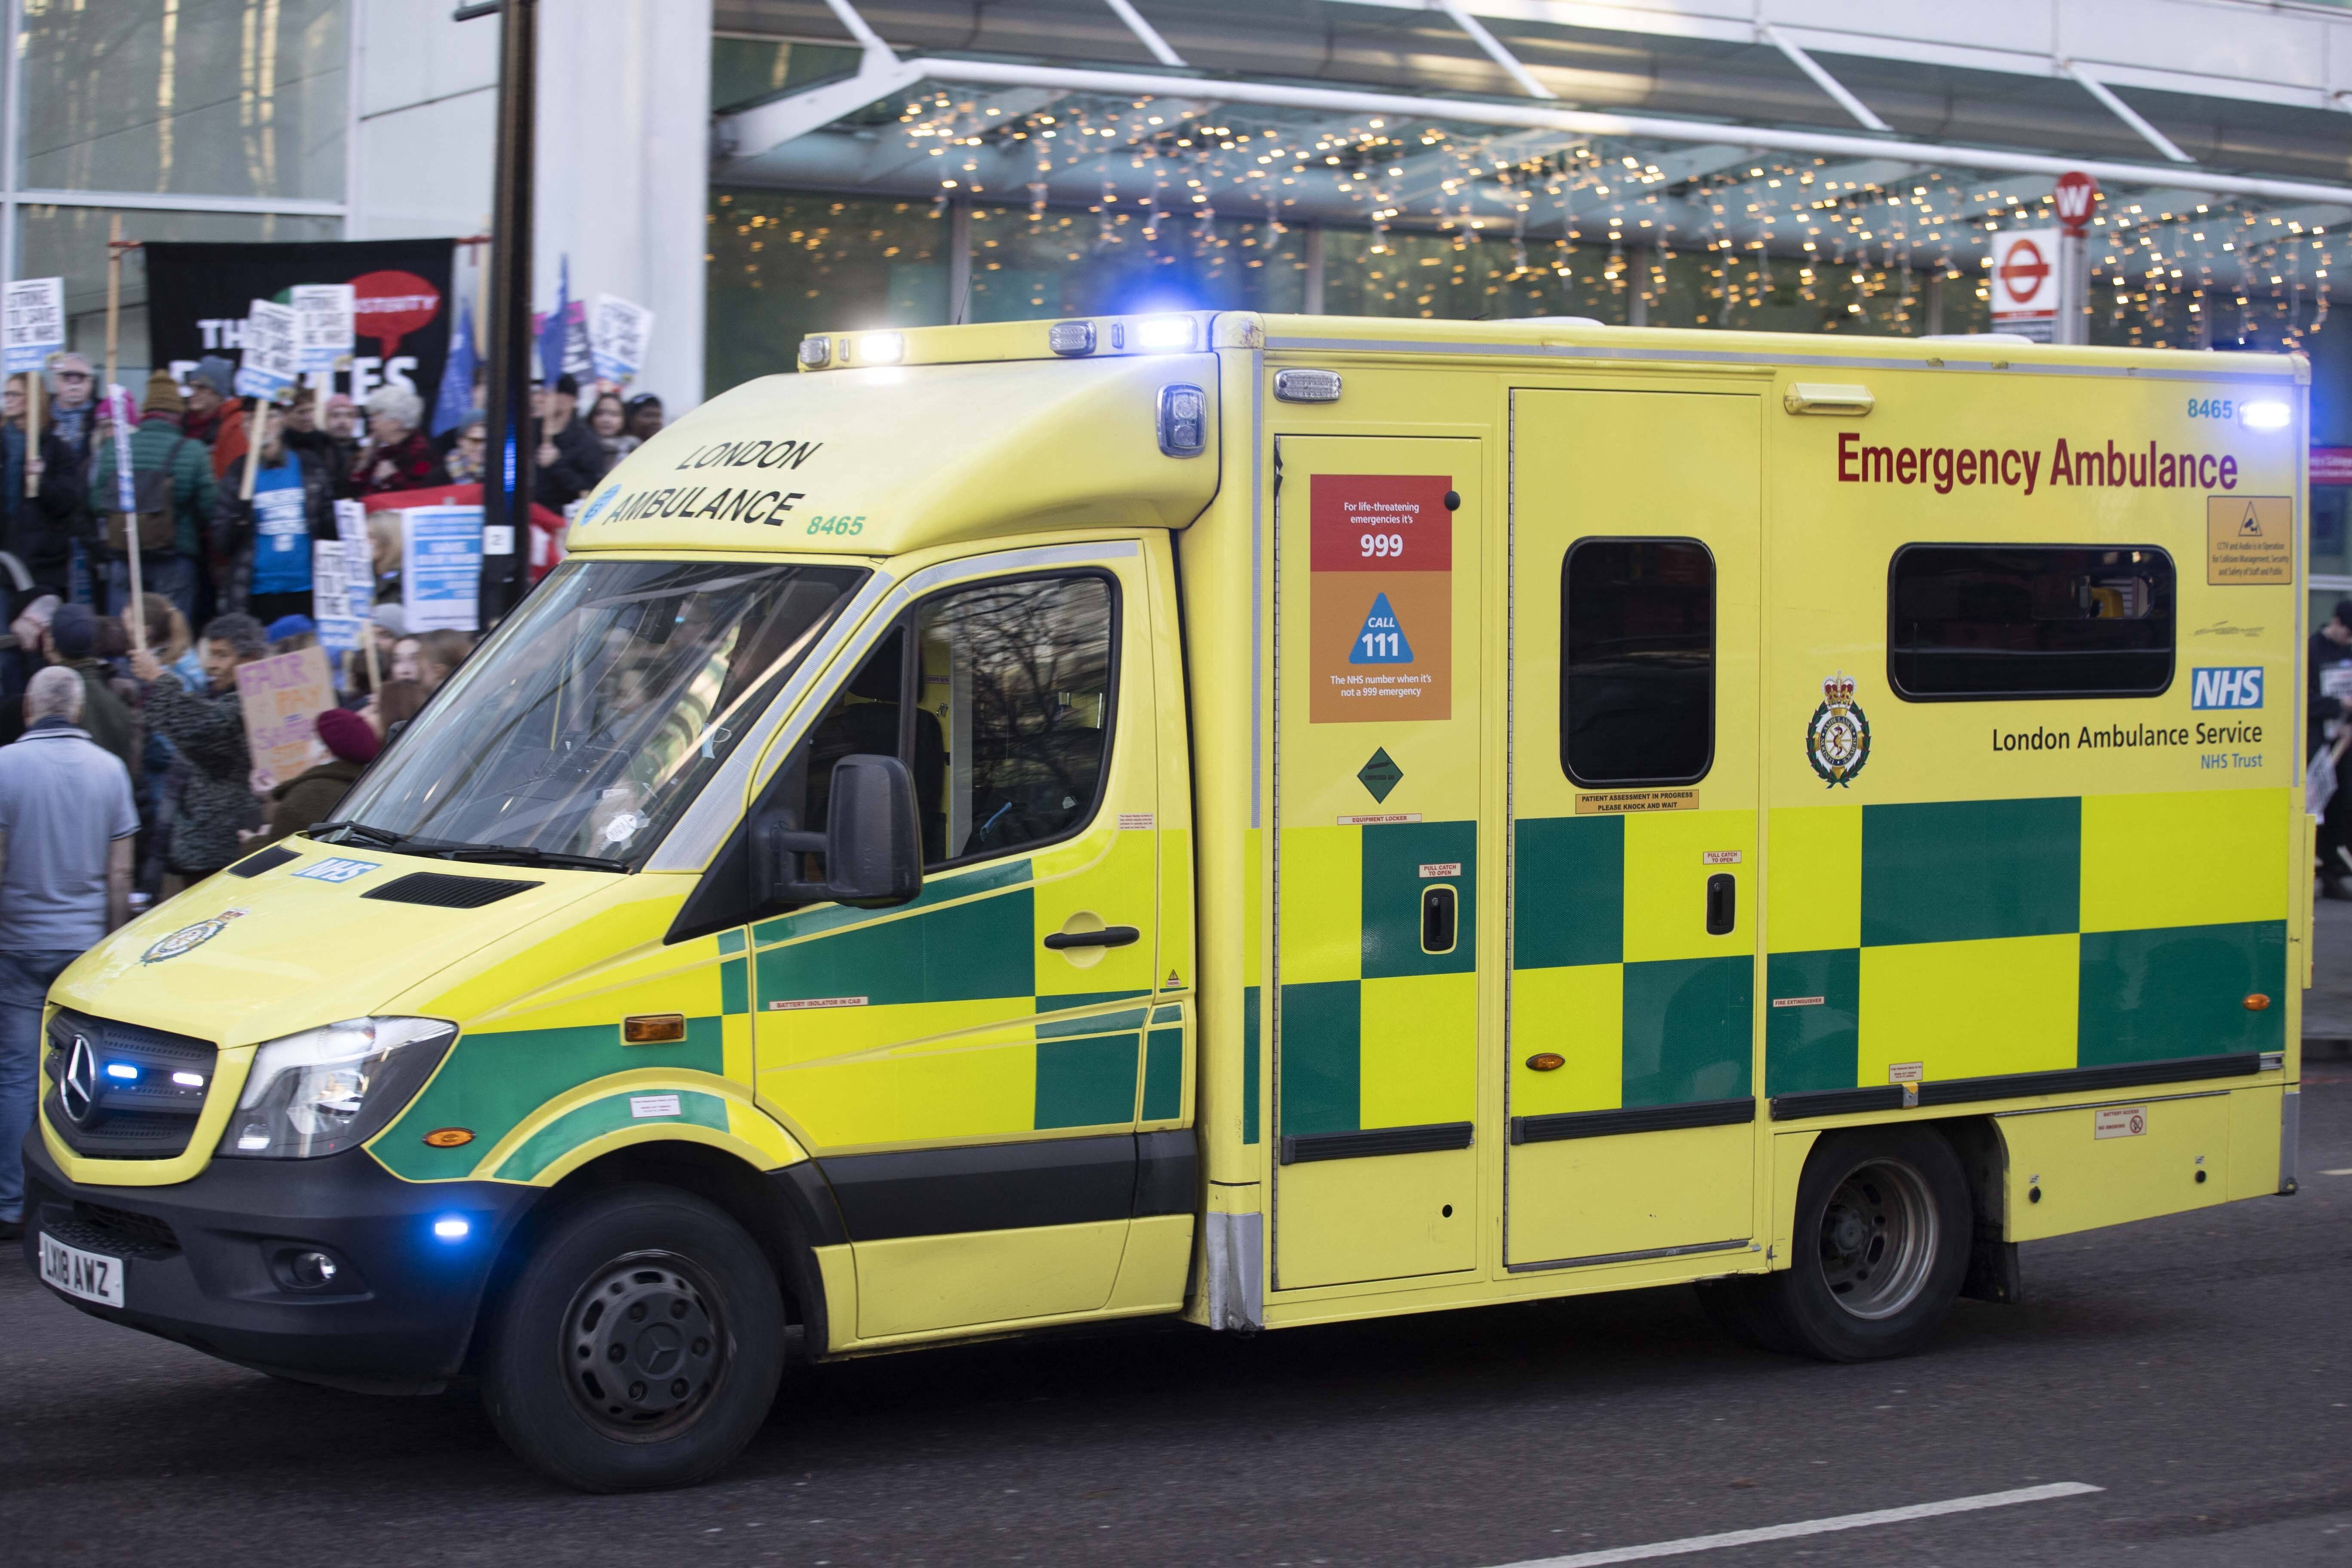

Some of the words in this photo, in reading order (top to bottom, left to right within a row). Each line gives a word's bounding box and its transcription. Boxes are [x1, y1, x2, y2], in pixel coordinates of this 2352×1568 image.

[196, 319, 249, 349] TH
[2187, 398, 2233, 420] 8465
[675, 441, 824, 470] LONDON
[1838, 432, 2040, 495] Emergency
[2050, 438, 2238, 490] Ambulance
[603, 487, 805, 527] AMBULANCE
[806, 516, 866, 535] 8465
[1344, 502, 1357, 511] For
[1359, 502, 1419, 513] life-threatening
[1351, 516, 1400, 525] emergencies
[1360, 534, 1403, 557] 999
[1368, 617, 1395, 628] CALL
[1362, 633, 1398, 657] 111
[1330, 676, 1345, 684] The
[1347, 675, 1363, 684] NHS
[1366, 675, 1395, 683] number
[1397, 674, 1418, 683] when
[2193, 670, 2261, 707] NHS
[1363, 688, 1377, 696] 999
[1379, 688, 1421, 698] emergency
[1823, 716, 1855, 733] AMBULANCE
[1993, 726, 2070, 751] London
[2077, 723, 2189, 749] Ambulance
[2196, 720, 2262, 744] Service
[2201, 754, 2227, 769] NHS
[2232, 753, 2263, 768] Trust
[294, 859, 377, 880] NHS
[74, 1256, 109, 1297] AWZ
